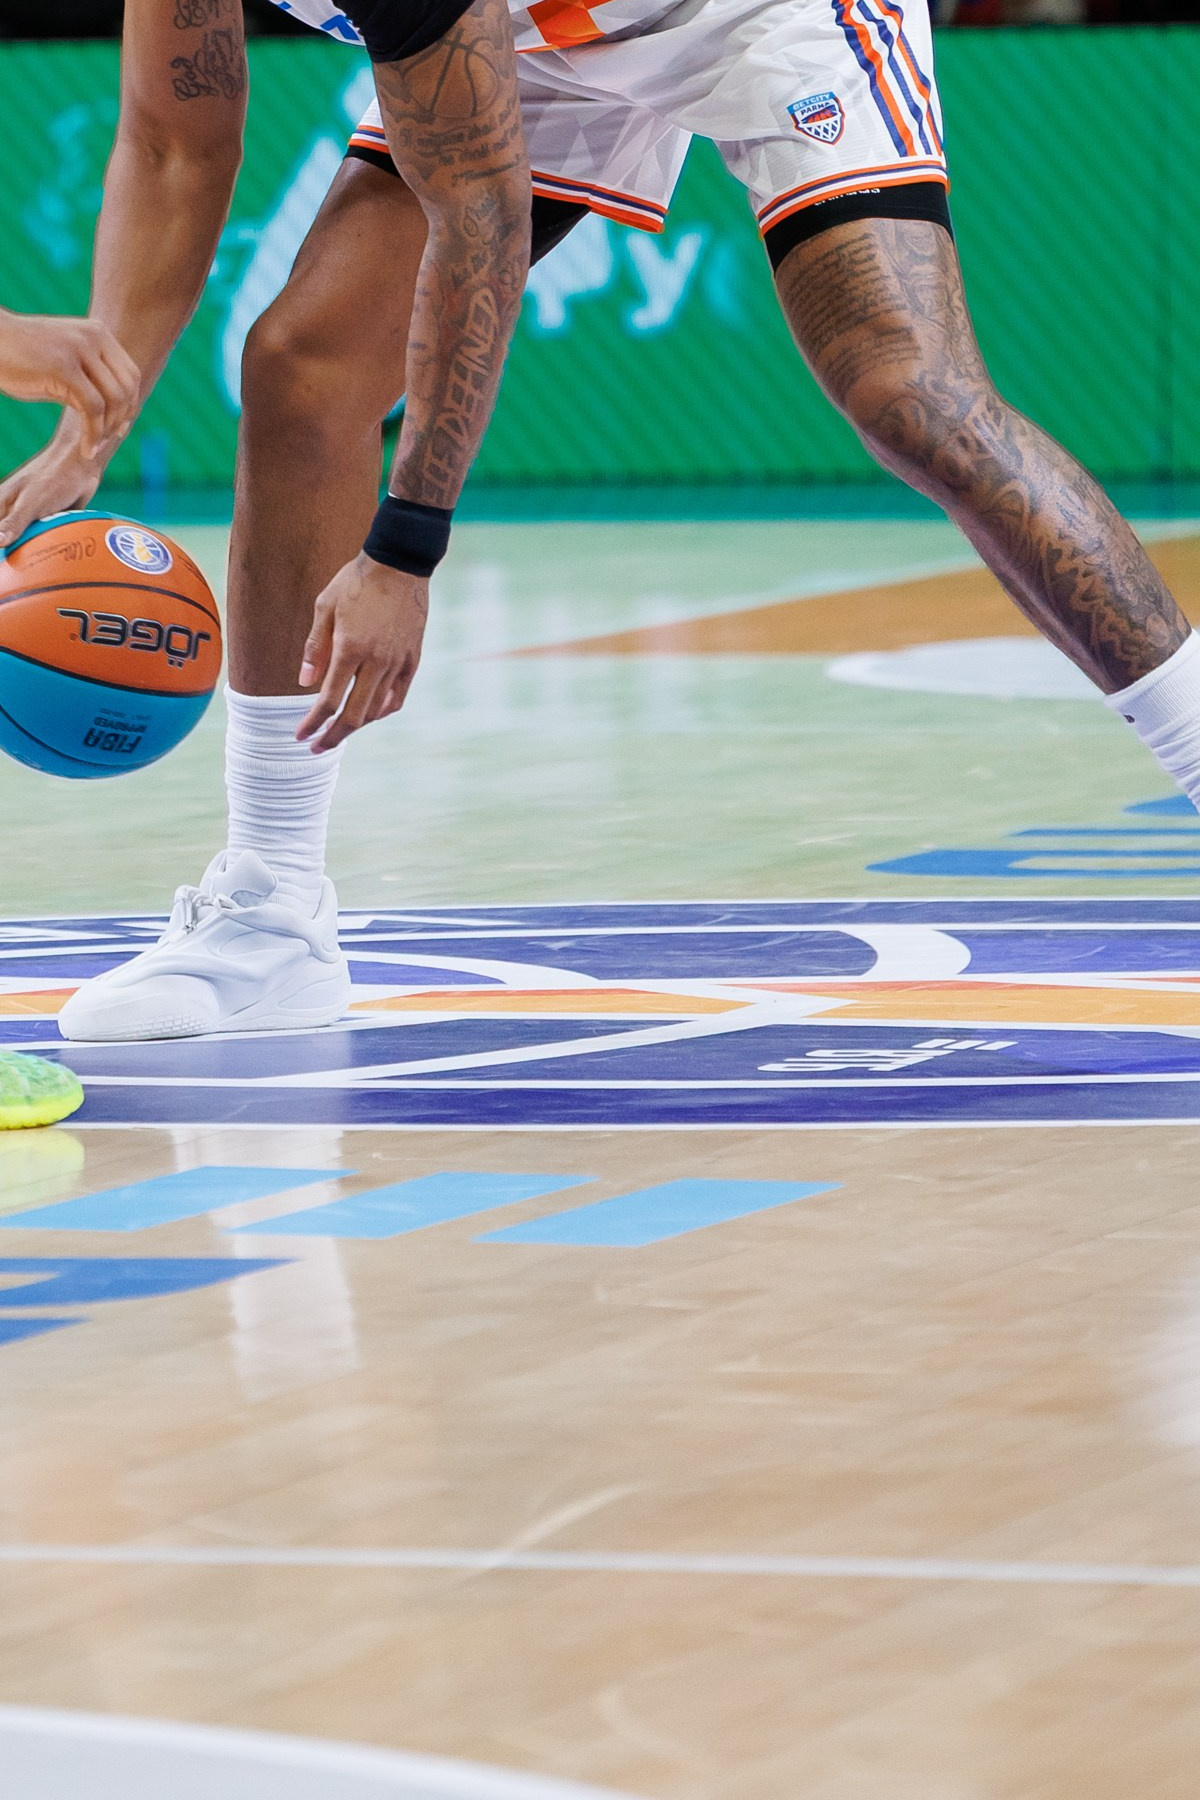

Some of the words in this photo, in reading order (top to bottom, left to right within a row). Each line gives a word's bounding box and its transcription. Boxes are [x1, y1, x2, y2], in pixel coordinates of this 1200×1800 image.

[792, 93, 831, 110] BETCITY
[56, 608, 211, 669] JÖGEL
[82, 727, 142, 755] FIBA
